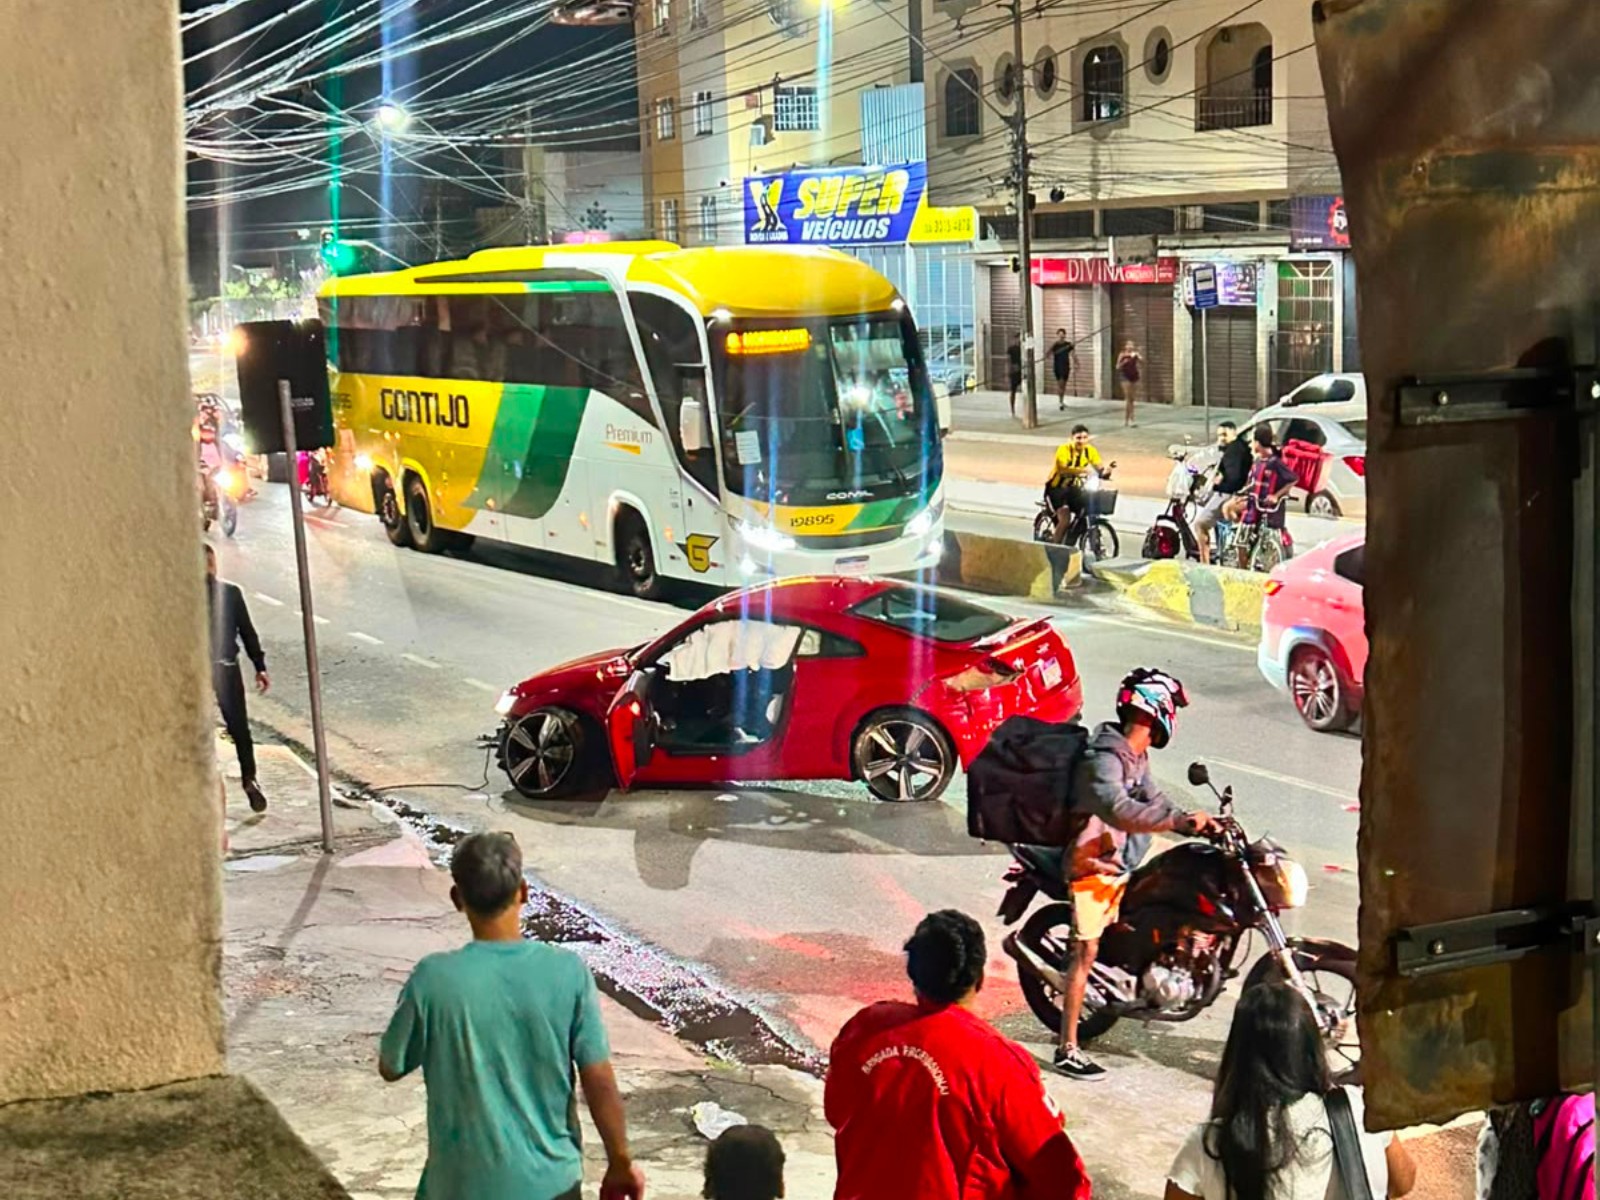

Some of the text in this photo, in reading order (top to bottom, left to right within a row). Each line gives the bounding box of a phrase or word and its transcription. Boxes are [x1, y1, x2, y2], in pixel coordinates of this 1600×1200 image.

[793, 169, 910, 219] SUPER
[801, 217, 891, 240] VEÍCULOS
[1068, 259, 1125, 281] DIVINA
[380, 388, 470, 428] GONTIJO
[606, 423, 653, 444] Premium
[790, 514, 834, 527] 19895
